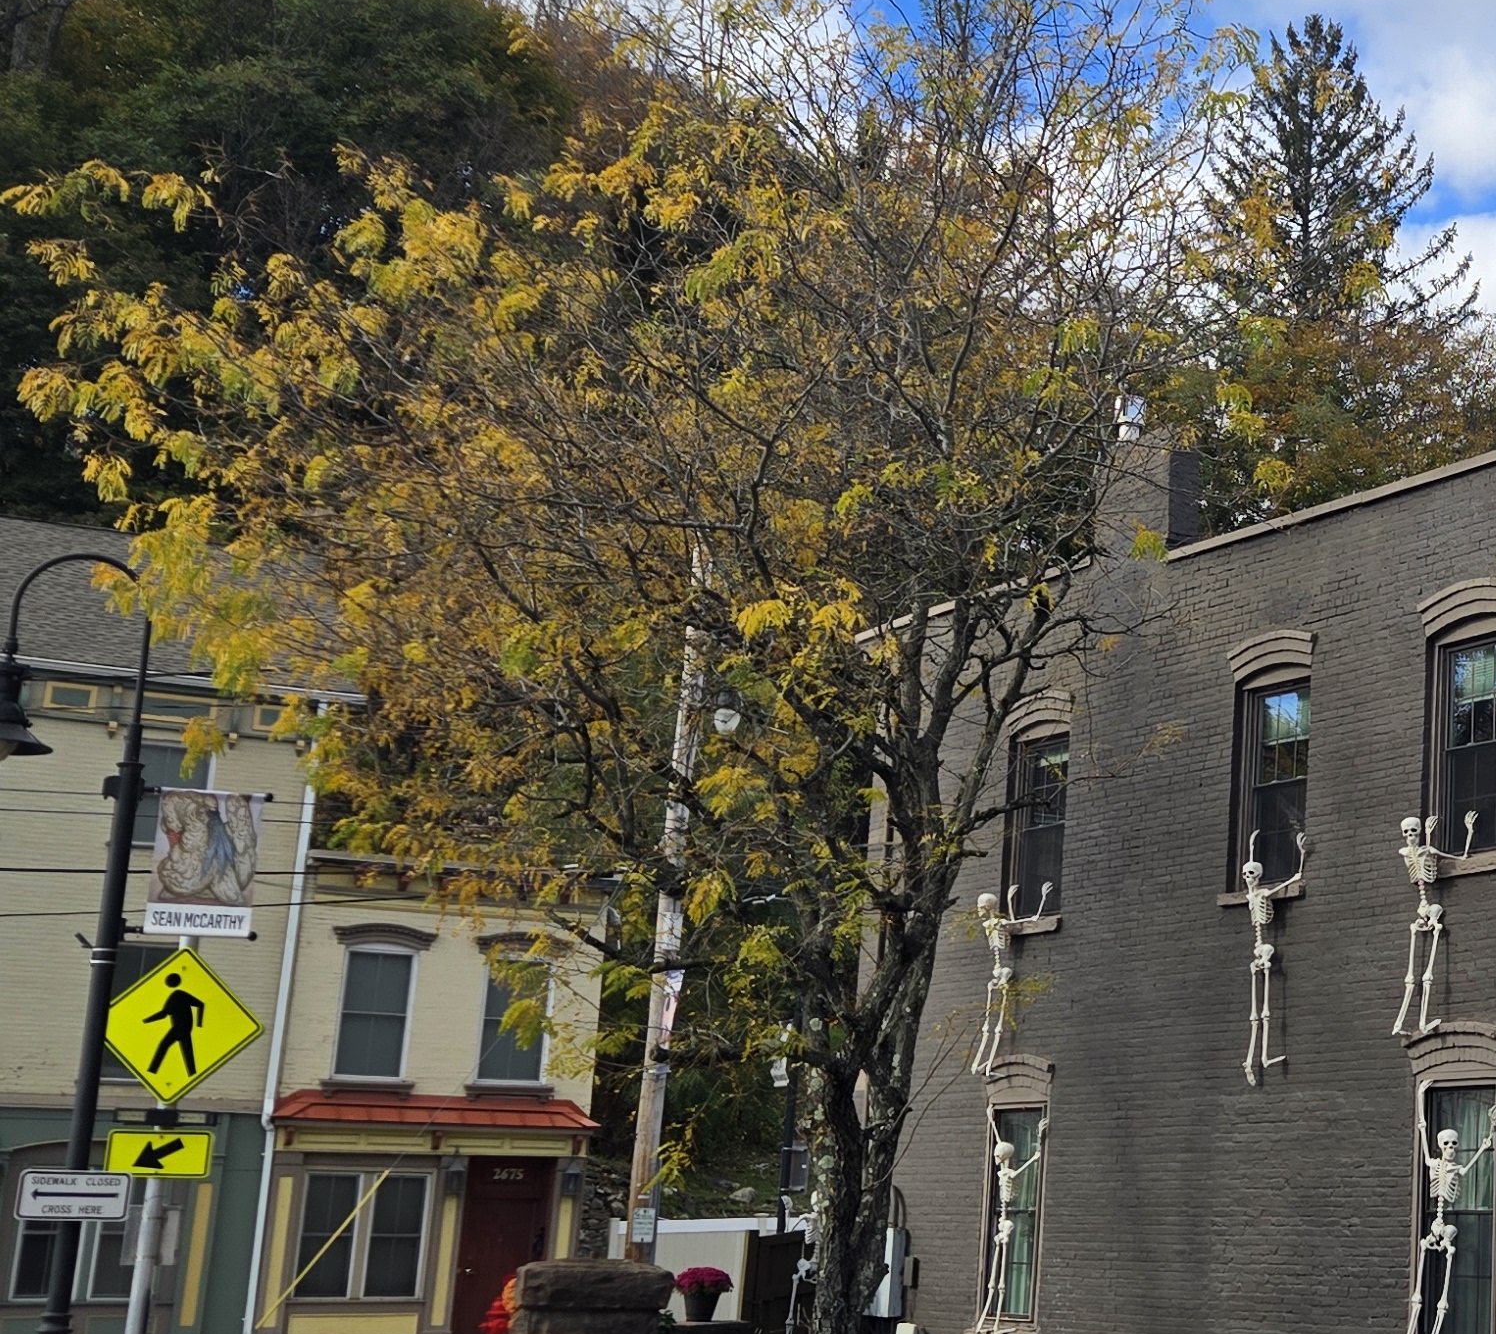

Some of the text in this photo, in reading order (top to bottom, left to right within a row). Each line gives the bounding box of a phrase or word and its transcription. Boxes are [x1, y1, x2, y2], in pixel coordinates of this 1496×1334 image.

[152, 911, 182, 927] SEAN
[493, 1167, 524, 1180] 2675
[31, 1176, 121, 1186] SIDEWALK CLOSED
[41, 1204, 103, 1214] CROSS HERE
